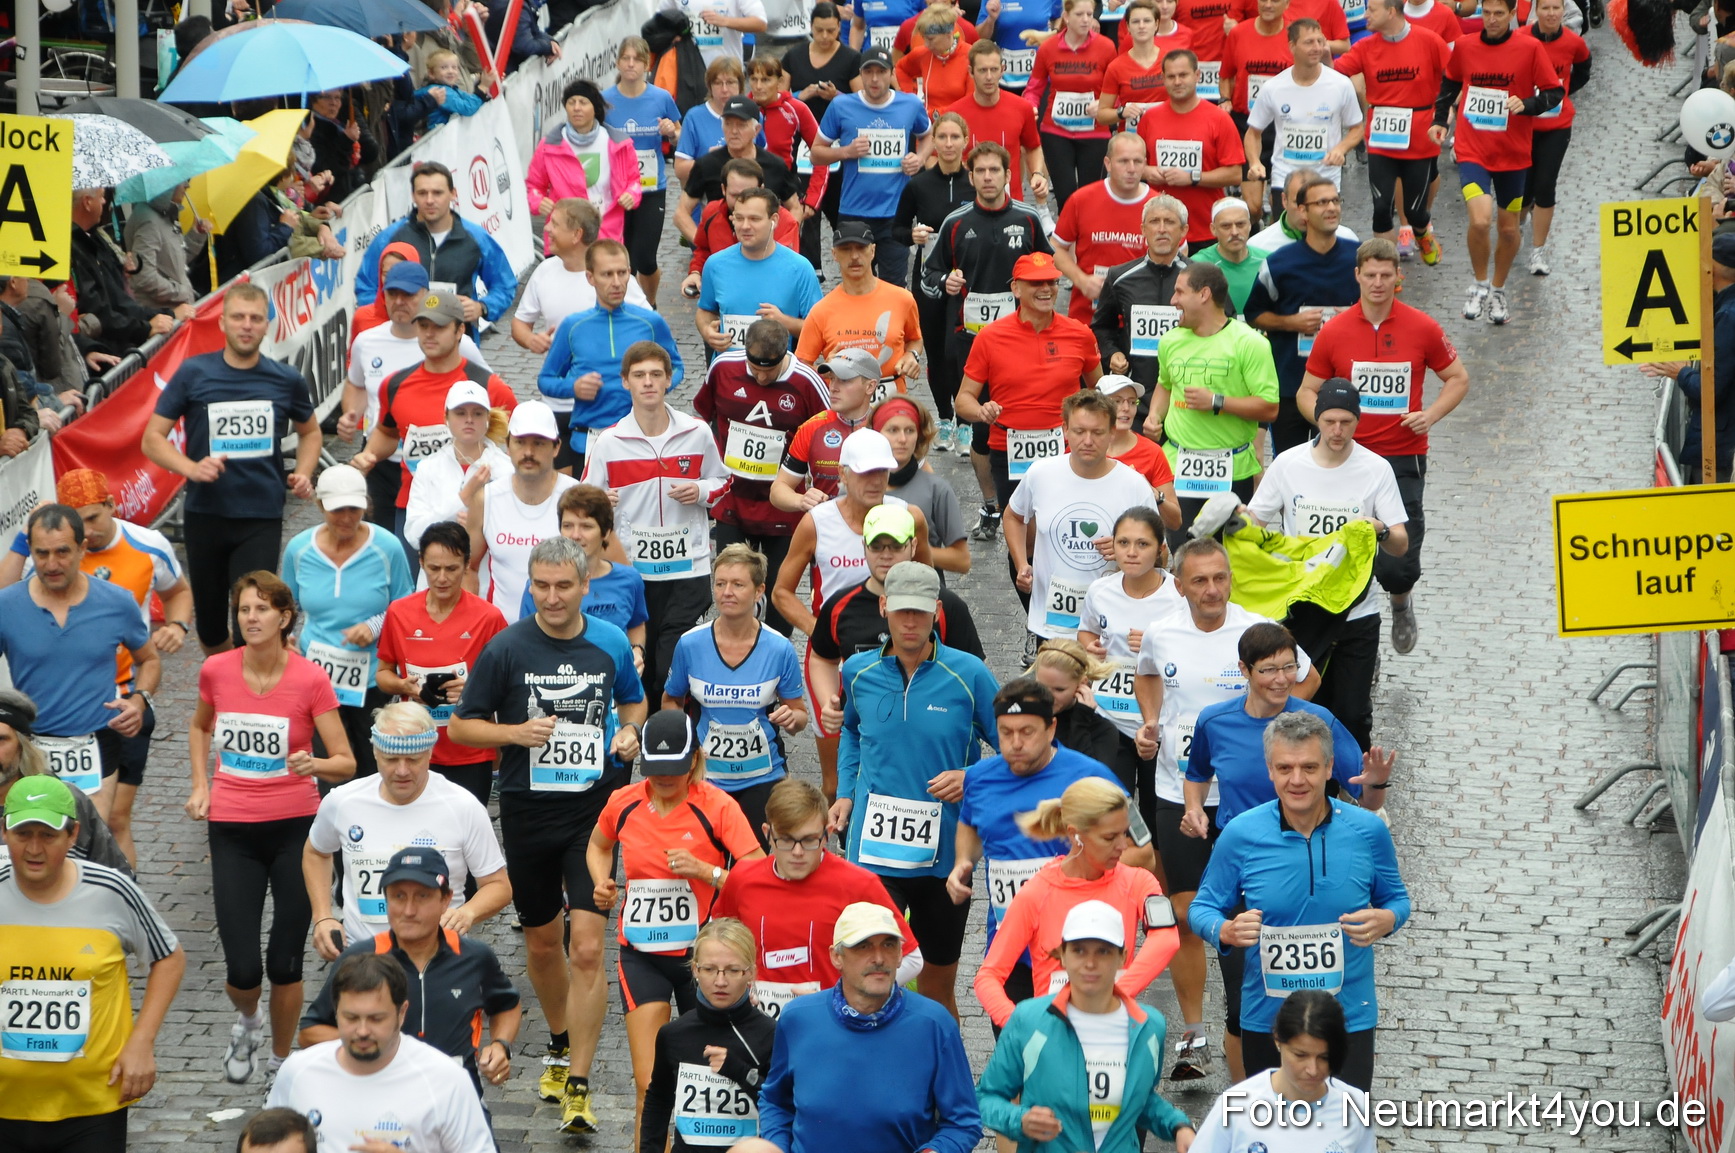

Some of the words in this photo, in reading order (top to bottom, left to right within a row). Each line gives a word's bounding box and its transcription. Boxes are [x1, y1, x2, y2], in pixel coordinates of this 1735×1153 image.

[1469, 97, 1503, 114] 2091
[1373, 117, 1407, 133] 3150
[1, 124, 60, 152] lock
[1286, 133, 1323, 150] 2020
[1160, 151, 1198, 168] 2280
[0, 164, 47, 243] A
[1614, 206, 1699, 238] Block
[1008, 235, 1023, 249] 44
[1091, 231, 1144, 243] NEUMARKT
[1626, 249, 1690, 329] A
[980, 305, 1001, 322] 97
[862, 329, 881, 337] 2008
[1358, 374, 1406, 394] 2098
[1367, 398, 1394, 408] Roland
[745, 400, 773, 427] A
[216, 415, 268, 436] 2539
[731, 426, 748, 436] PARTL
[749, 430, 776, 441] Neumarkt
[221, 442, 263, 450] Alexander
[743, 438, 767, 461] 68
[1013, 438, 1059, 459] 2099
[739, 461, 763, 474] Martin
[1180, 458, 1227, 477] 2935
[1186, 482, 1219, 492] Christian
[653, 530, 682, 538] Neumarkt
[1069, 521, 1080, 538] I
[636, 537, 688, 560] 2864
[1570, 530, 1735, 563] Schnuppe
[653, 564, 671, 573] Luis
[1051, 581, 1068, 594] PARTL
[1636, 567, 1697, 596] lauf
[558, 664, 577, 674] 40.
[525, 673, 603, 685] Hermannslauf
[703, 683, 761, 701] Margraf
[1112, 700, 1130, 711] Lisa
[241, 720, 275, 728] Neumarkt
[222, 729, 281, 756] 2088
[710, 736, 763, 760] 2234
[50, 748, 93, 774] 566
[538, 741, 597, 766] 2584
[235, 757, 267, 770] Andrea
[731, 764, 744, 773] Evi
[555, 772, 579, 782] Mark
[869, 800, 891, 811] PARTL
[892, 804, 928, 816] Neumarkt
[870, 812, 932, 844] 3154
[648, 886, 682, 894] Neumarkt
[995, 878, 1030, 905] 31
[630, 896, 691, 923] 2756
[648, 930, 669, 942] Jina
[1261, 932, 1287, 941] PARTL
[1289, 932, 1328, 941] Neumarkt
[776, 952, 796, 963] DEHN
[1268, 942, 1337, 971] 2356
[10, 966, 75, 981] FRANK
[1281, 977, 1326, 989] Berthold
[1, 987, 29, 997] PARTL
[32, 987, 74, 997] Neumarkt
[7, 1000, 81, 1031] 2266
[26, 1037, 58, 1051] Frank
[679, 1071, 703, 1082] PARTL
[682, 1084, 751, 1117] 2125
[694, 1121, 737, 1135] Simone
